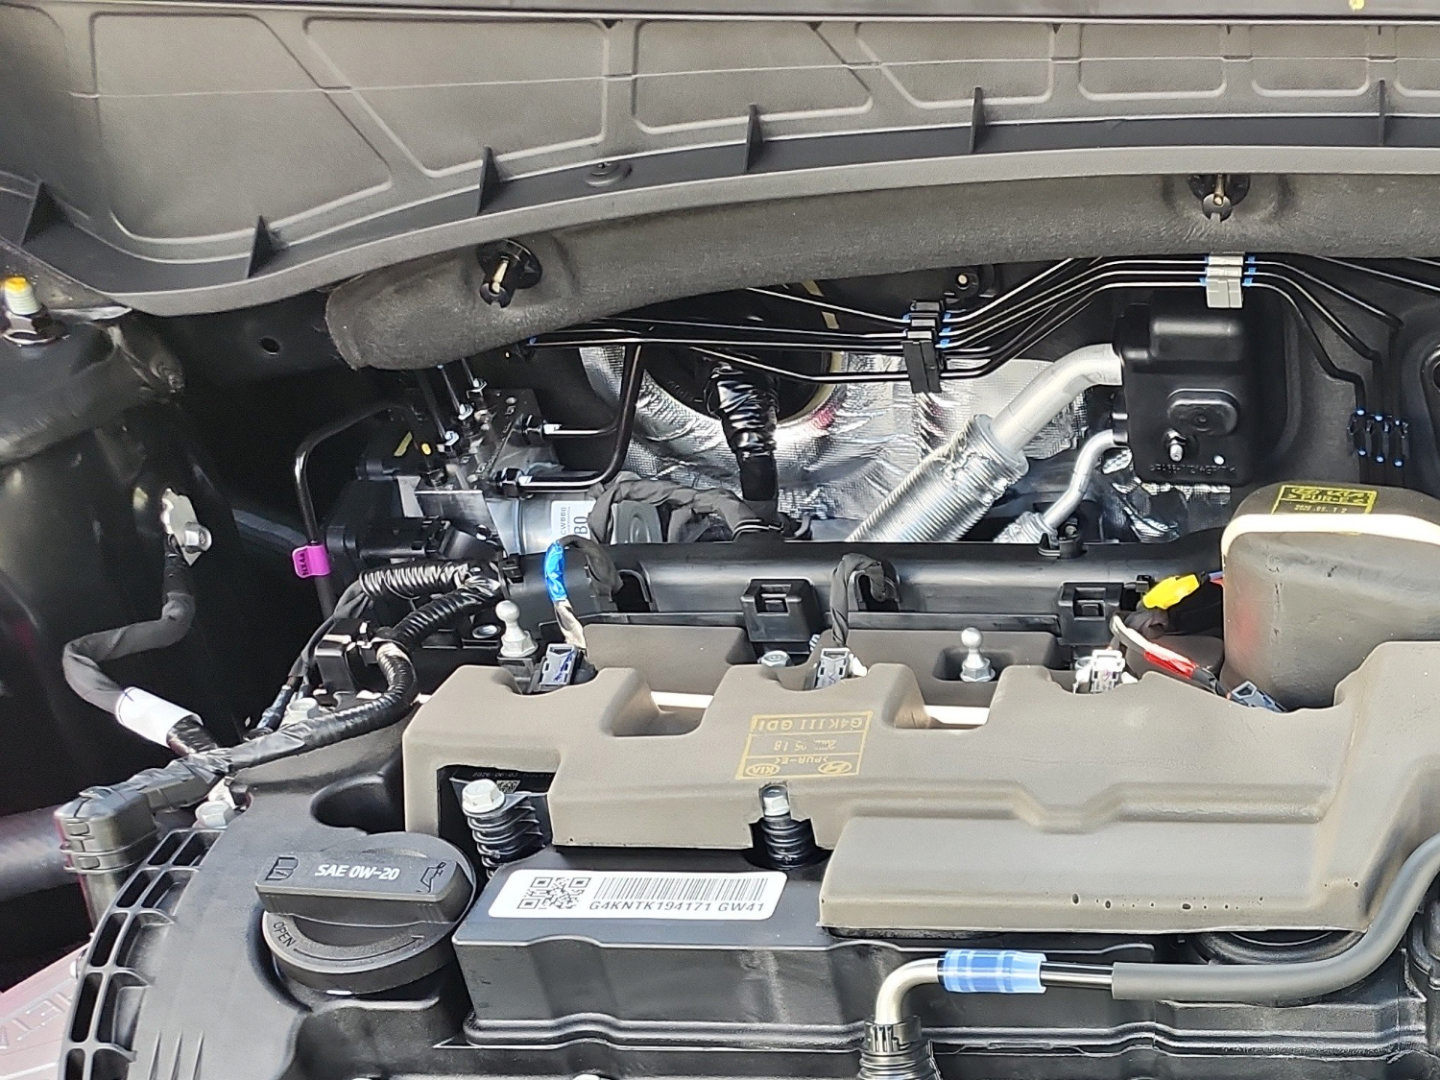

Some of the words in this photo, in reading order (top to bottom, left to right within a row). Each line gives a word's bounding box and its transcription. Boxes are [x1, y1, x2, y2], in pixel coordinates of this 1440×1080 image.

[314, 863, 350, 878] SAE
[348, 865, 400, 881] 0W-20
[717, 901, 765, 912] GW41
[272, 921, 296, 947] OPEN
